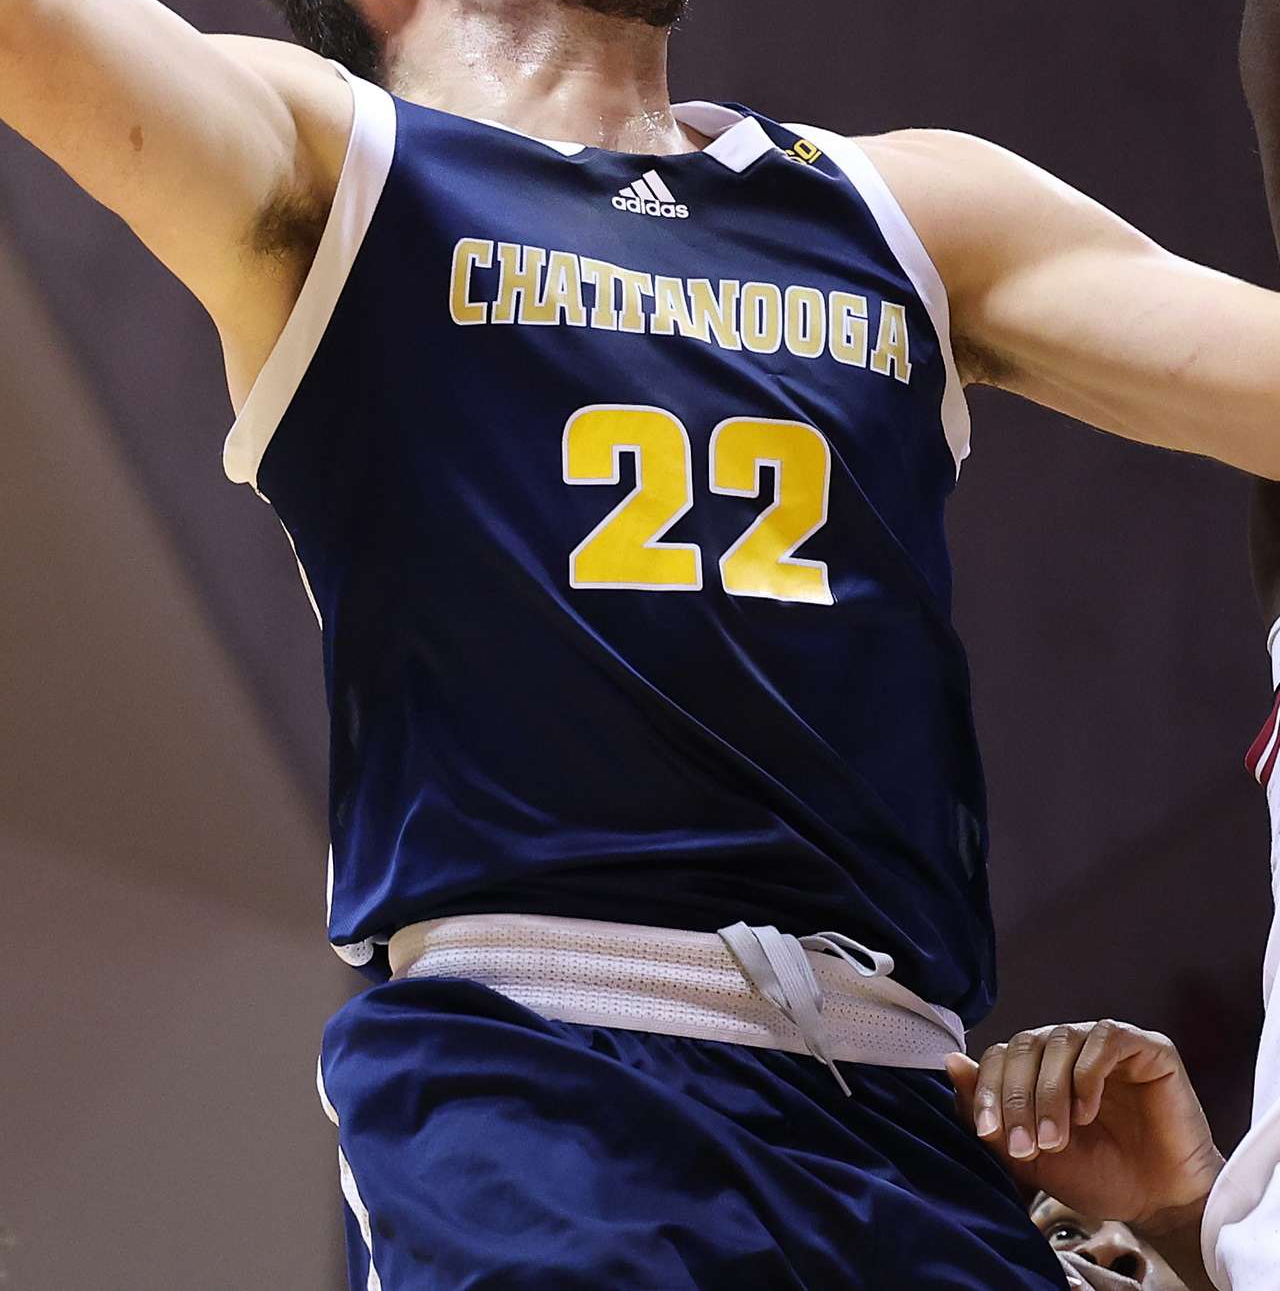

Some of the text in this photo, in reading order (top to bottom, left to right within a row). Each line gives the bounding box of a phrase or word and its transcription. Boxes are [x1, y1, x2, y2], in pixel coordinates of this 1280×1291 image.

[611, 196, 690, 219] adidas
[450, 237, 912, 385] CHATTANOOGA
[562, 403, 835, 606] 22
